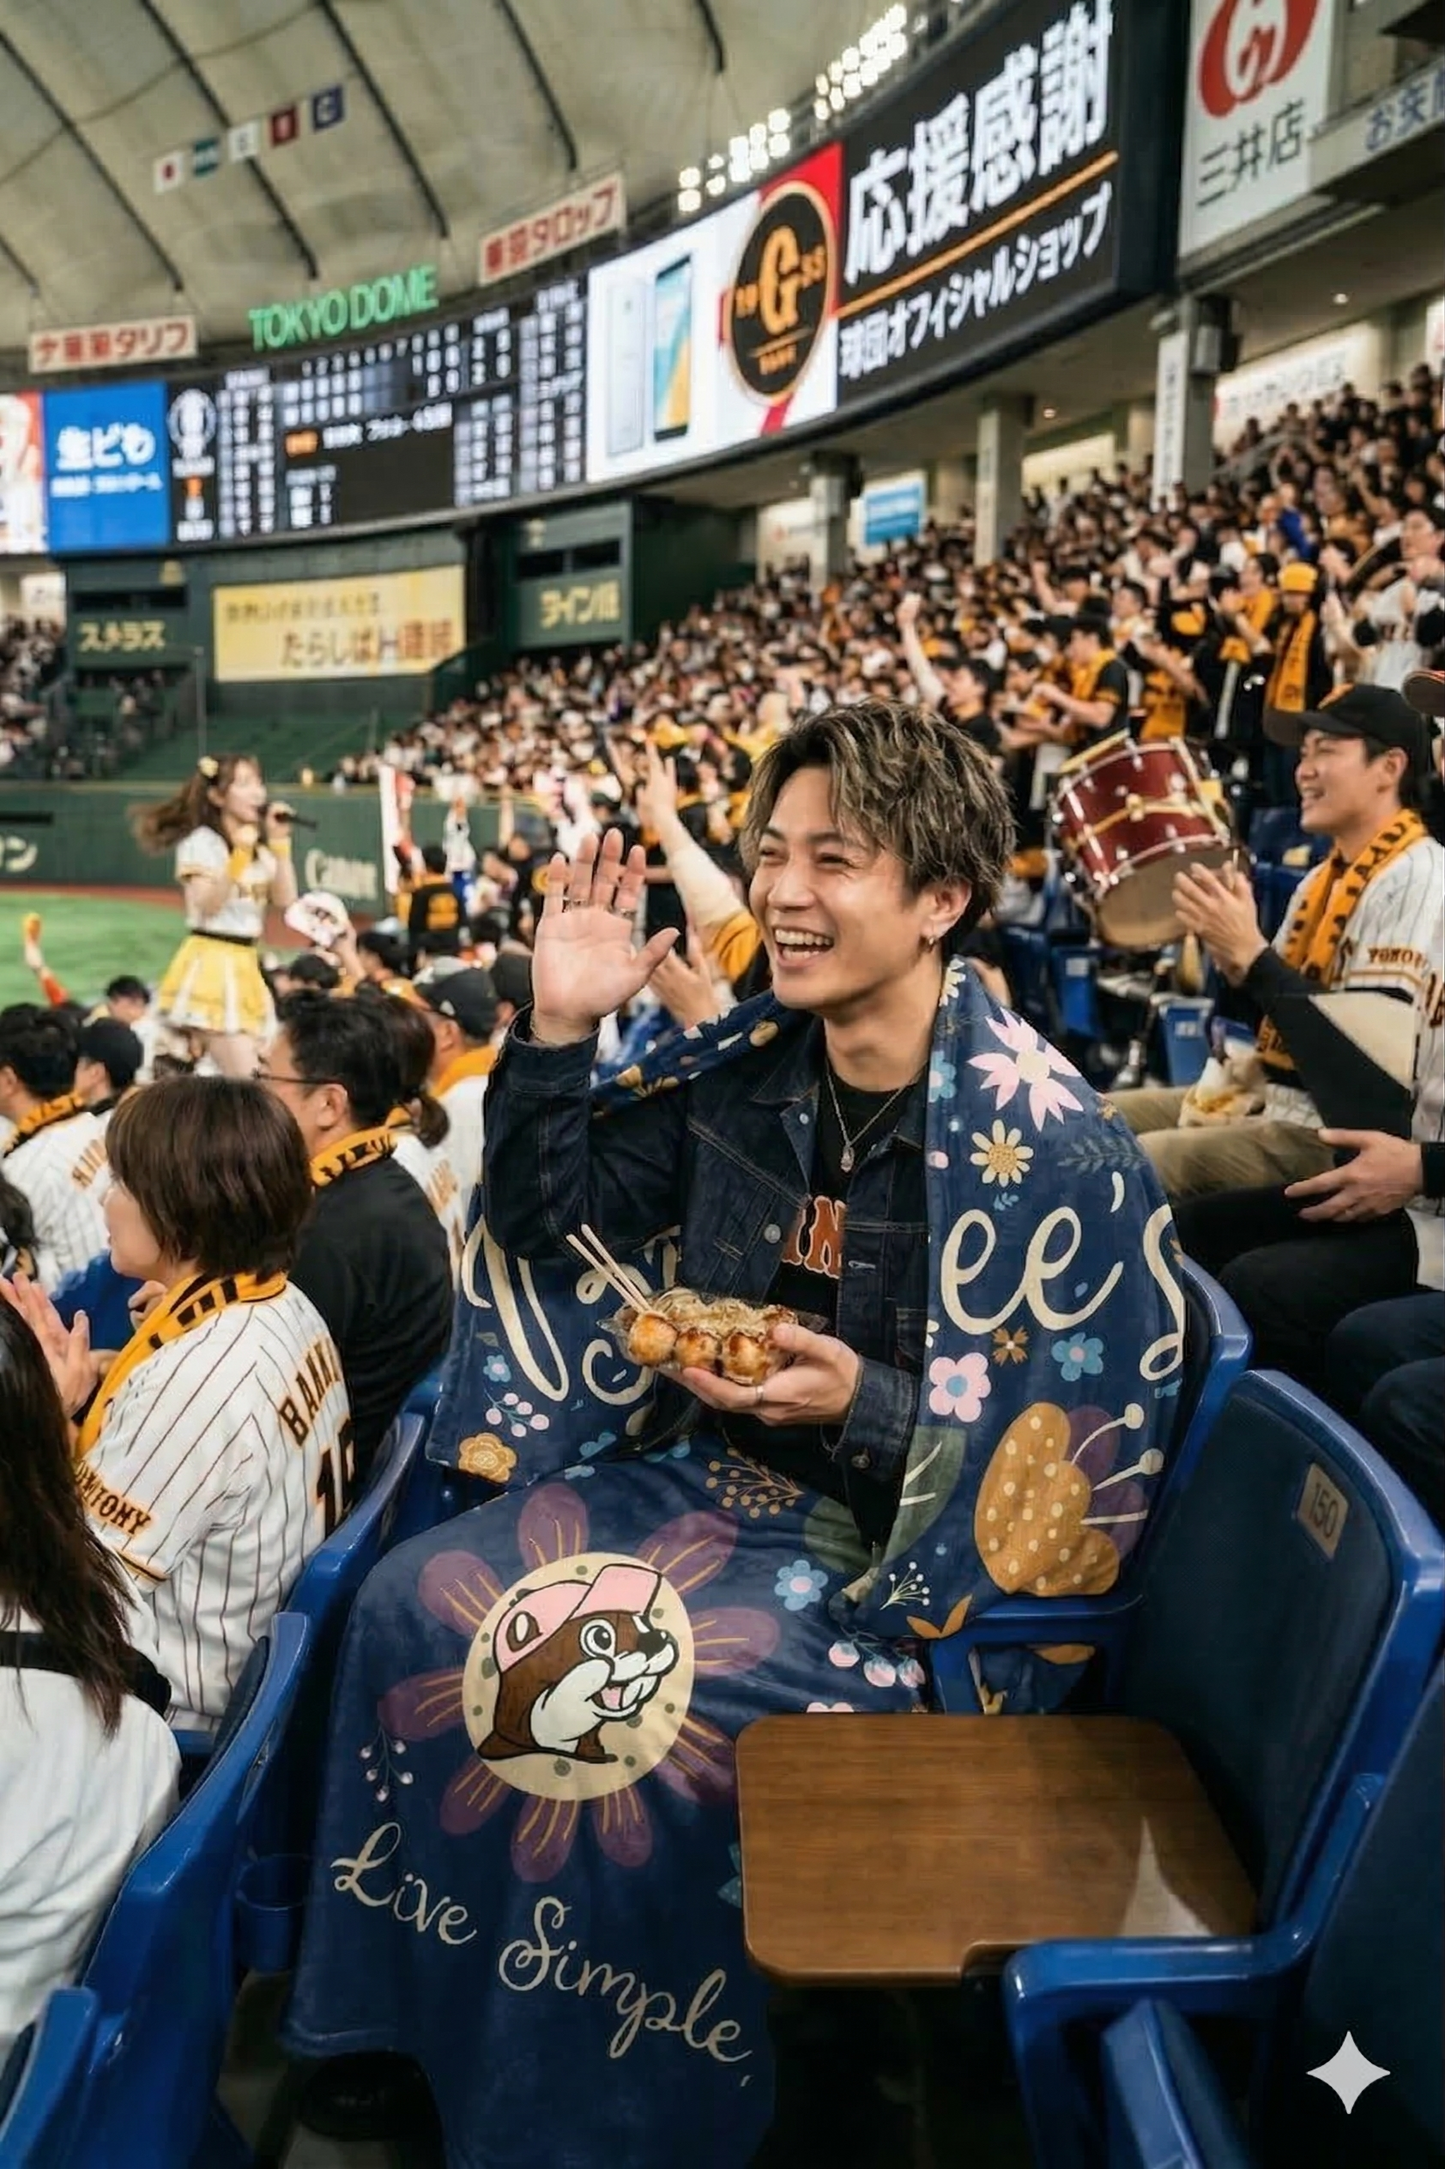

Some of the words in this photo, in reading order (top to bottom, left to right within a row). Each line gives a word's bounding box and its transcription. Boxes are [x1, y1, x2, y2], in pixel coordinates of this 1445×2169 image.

[844, 0, 1113, 287] 応援感謝
[1196, 98, 1305, 207] 三井店
[248, 288, 349, 352] TOKYO
[350, 264, 439, 331] DOME
[1308, 1482, 1339, 1539] 150
[330, 1821, 477, 1946] Live
